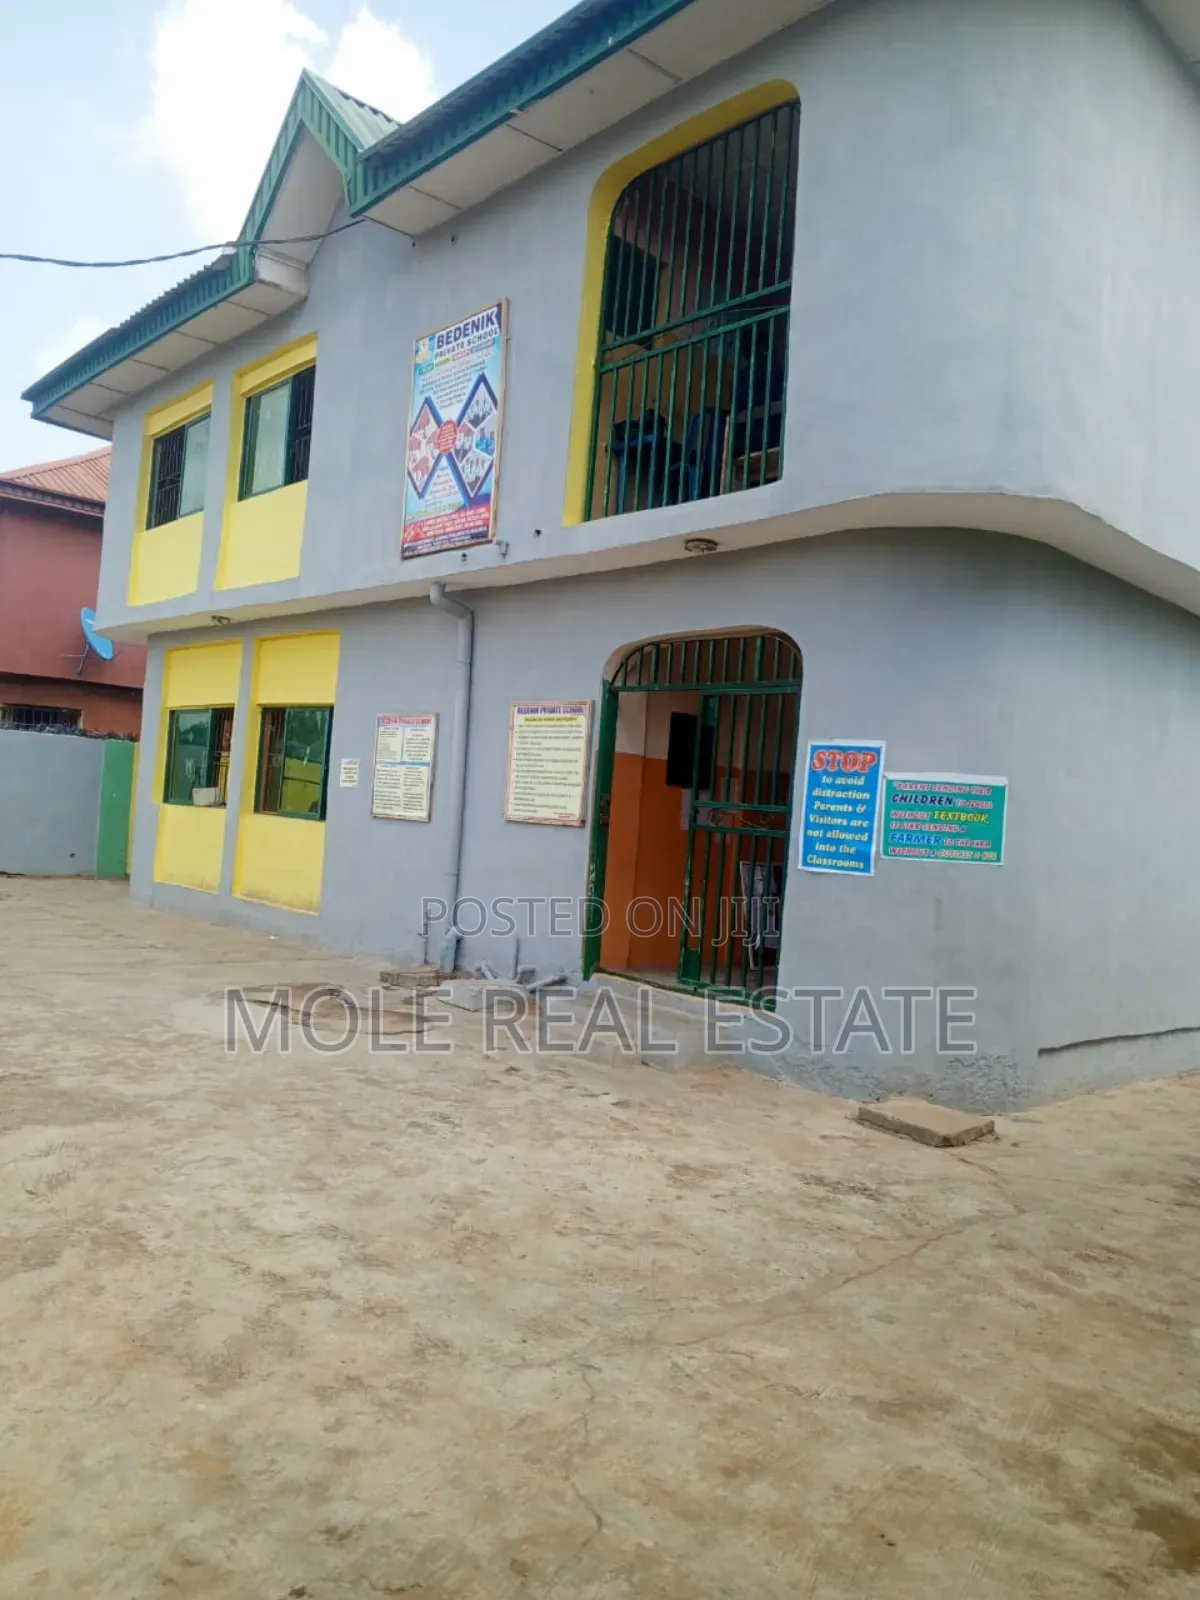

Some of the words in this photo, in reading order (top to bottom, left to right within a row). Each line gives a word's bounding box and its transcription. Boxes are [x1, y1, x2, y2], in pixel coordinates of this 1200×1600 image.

[436, 310, 496, 349] BEDENIK
[434, 340, 465, 360] PRIVATE
[467, 327, 498, 347] SCHOOL
[811, 750, 878, 773] STOP
[835, 776, 865, 785] avoid
[812, 788, 871, 799] distraction
[891, 794, 954, 806] CHILDREN
[814, 801, 852, 812] Parents
[856, 803, 867, 813] &
[809, 814, 848, 825] Visitors
[826, 830, 869, 841] allowed
[890, 832, 942, 846] FARMER
[815, 842, 836, 852] into
[839, 844, 857, 854] the
[807, 854, 865, 869] Classrooms
